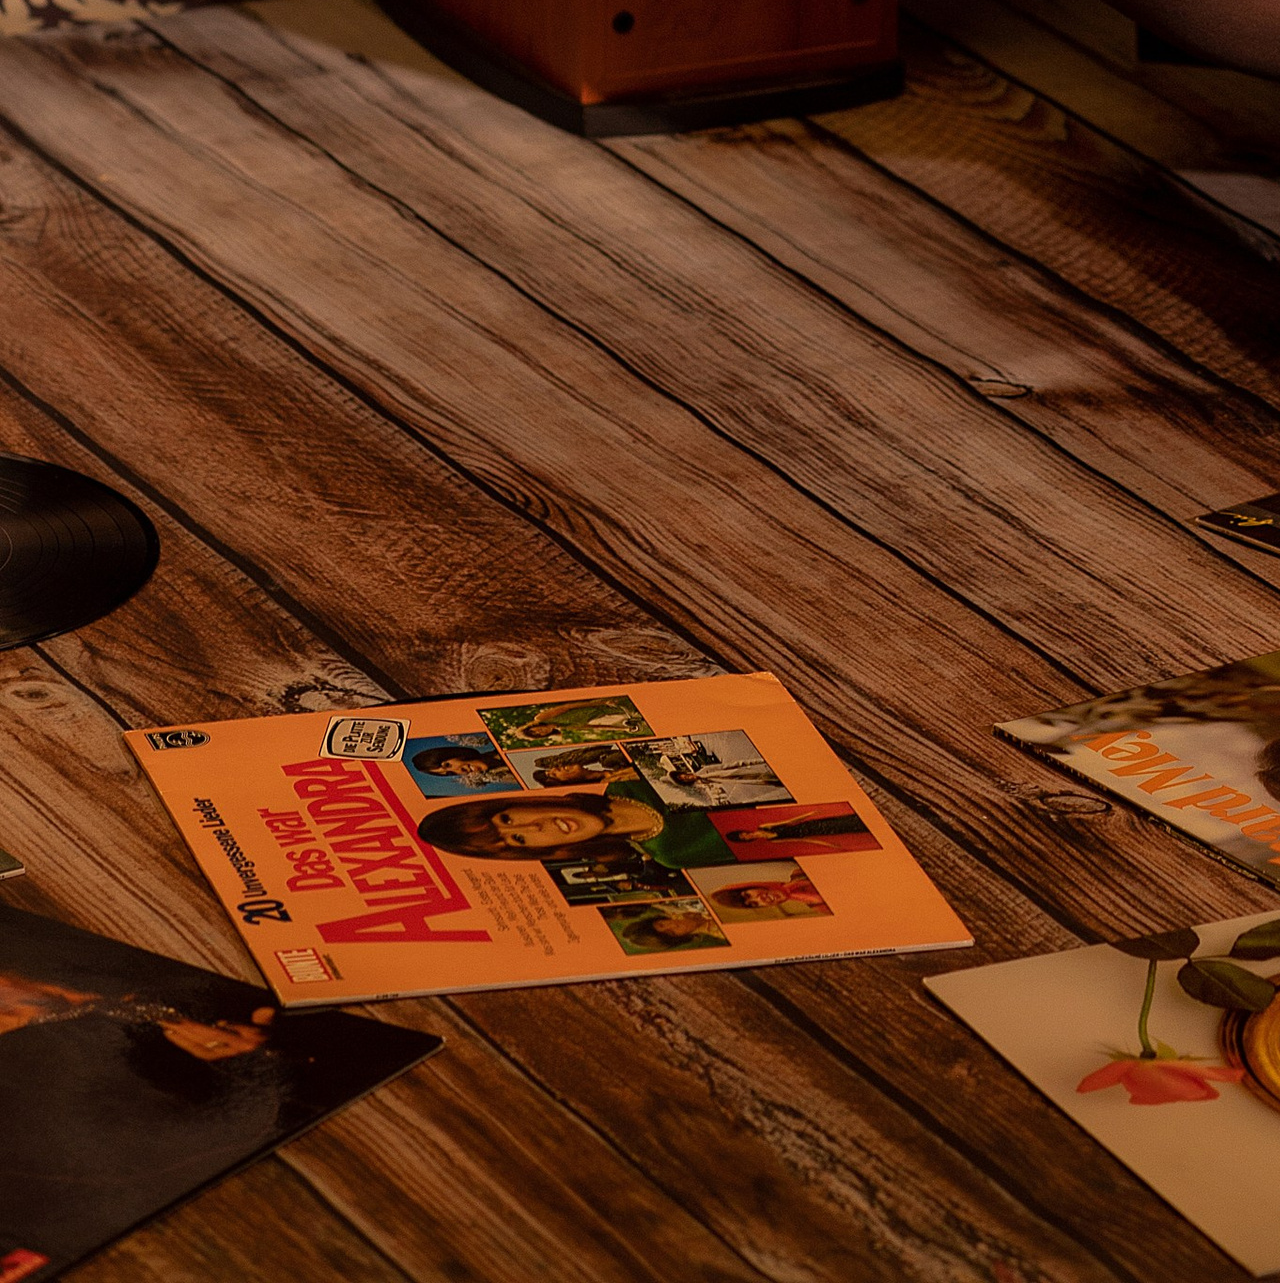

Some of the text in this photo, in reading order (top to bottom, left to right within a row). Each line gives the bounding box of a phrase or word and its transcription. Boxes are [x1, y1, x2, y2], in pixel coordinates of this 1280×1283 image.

[1072, 729, 1214, 795] Mey
[193, 798, 293, 925] 20 Unvergessene Lieder
[257, 807, 346, 893] Das war
[281, 758, 493, 944] ALEXANDRA
